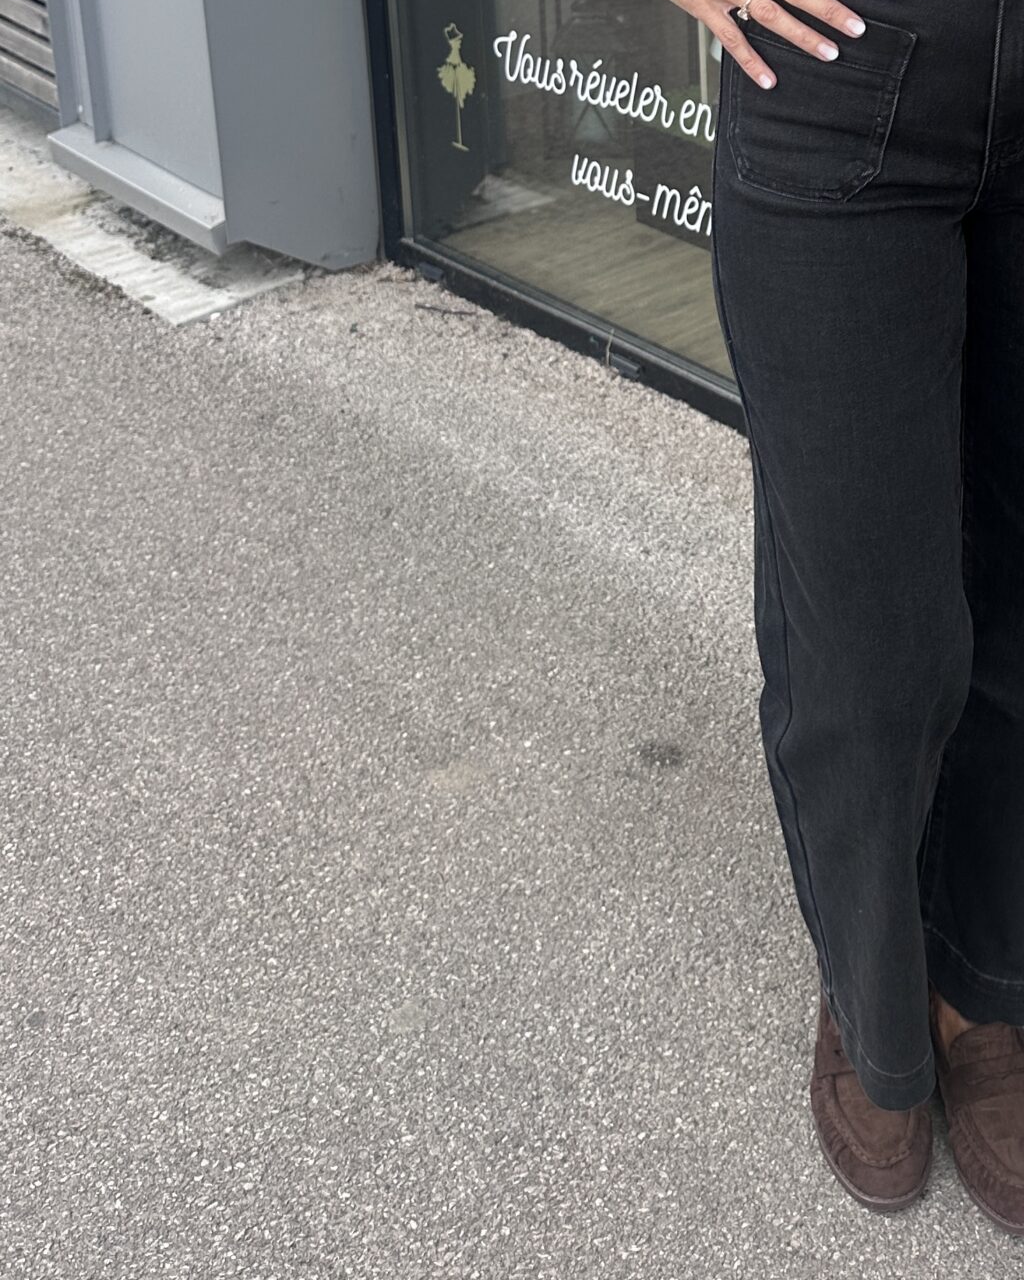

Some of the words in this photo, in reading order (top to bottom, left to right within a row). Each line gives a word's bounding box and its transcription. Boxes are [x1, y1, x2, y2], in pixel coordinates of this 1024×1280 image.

[492, 30, 566, 95] Vous
[569, 59, 675, 128] réveler
[679, 98, 714, 142] en
